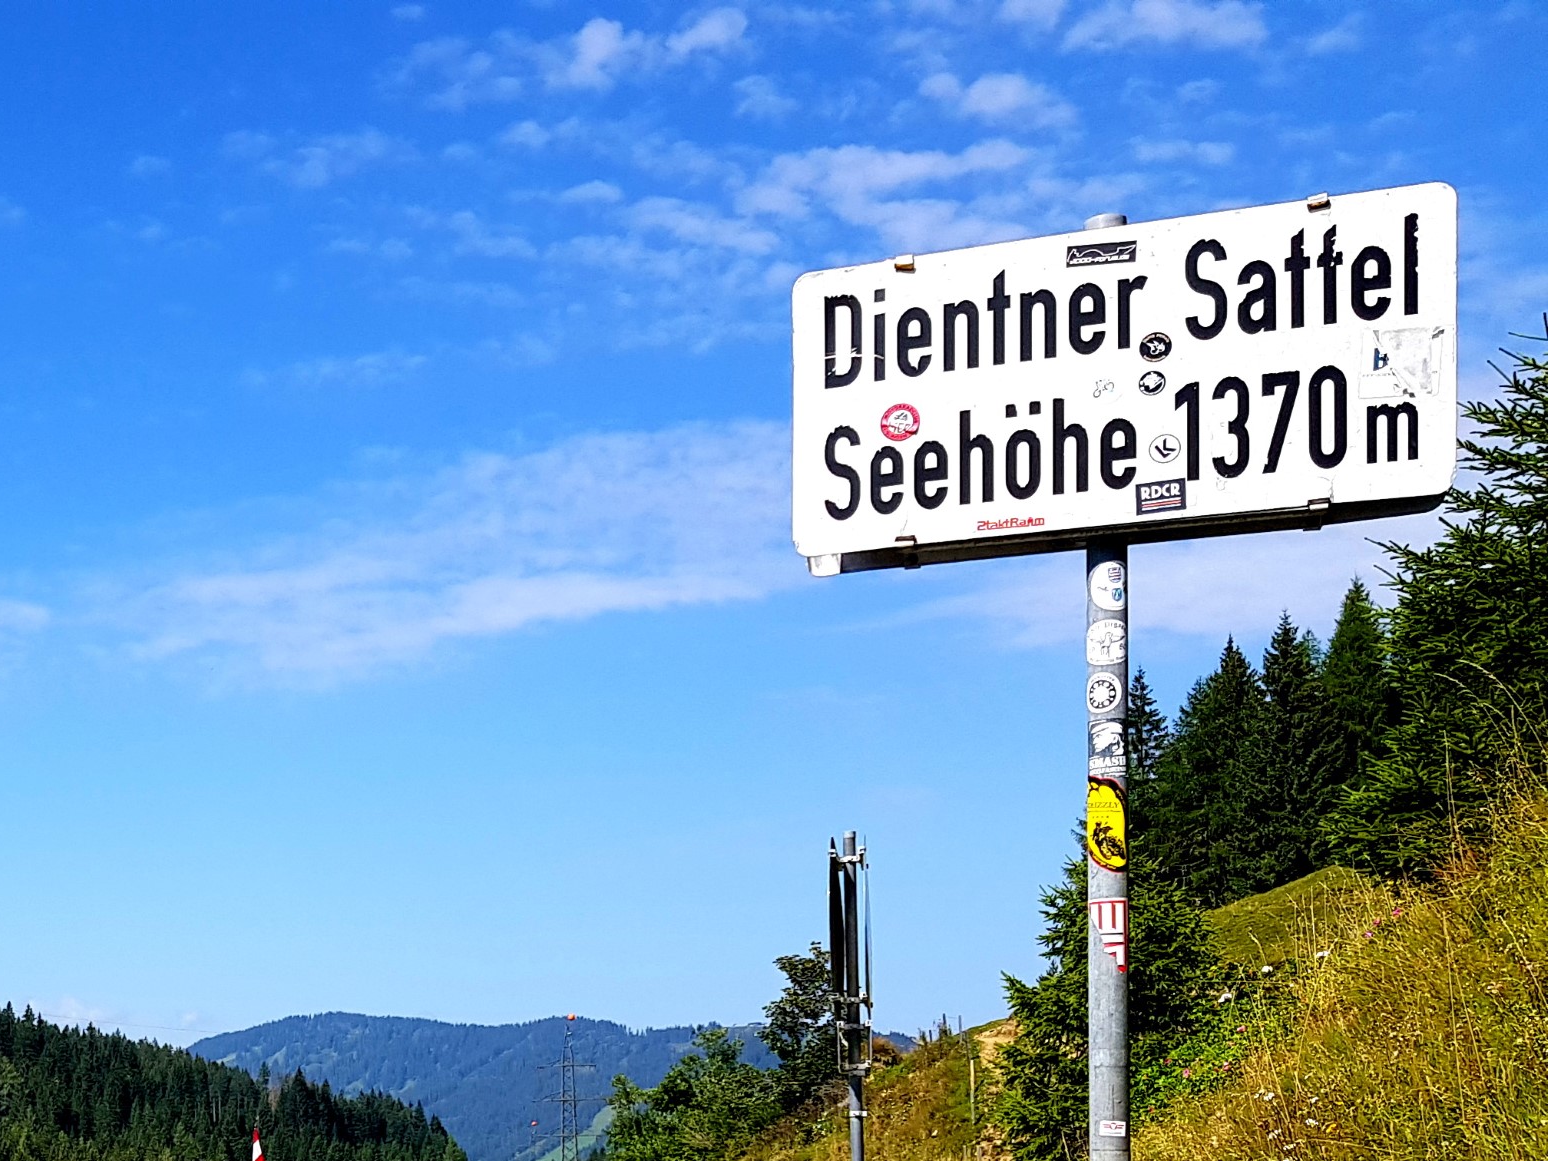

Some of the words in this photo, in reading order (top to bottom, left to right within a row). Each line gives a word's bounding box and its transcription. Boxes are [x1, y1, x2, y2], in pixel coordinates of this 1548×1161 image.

[824, 269, 1149, 389] Dientner
[824, 397, 1137, 521] Seehöhe
[1174, 365, 1348, 481] 1370
[1366, 401, 1419, 464] m
[1140, 482, 1181, 500] RDCR
